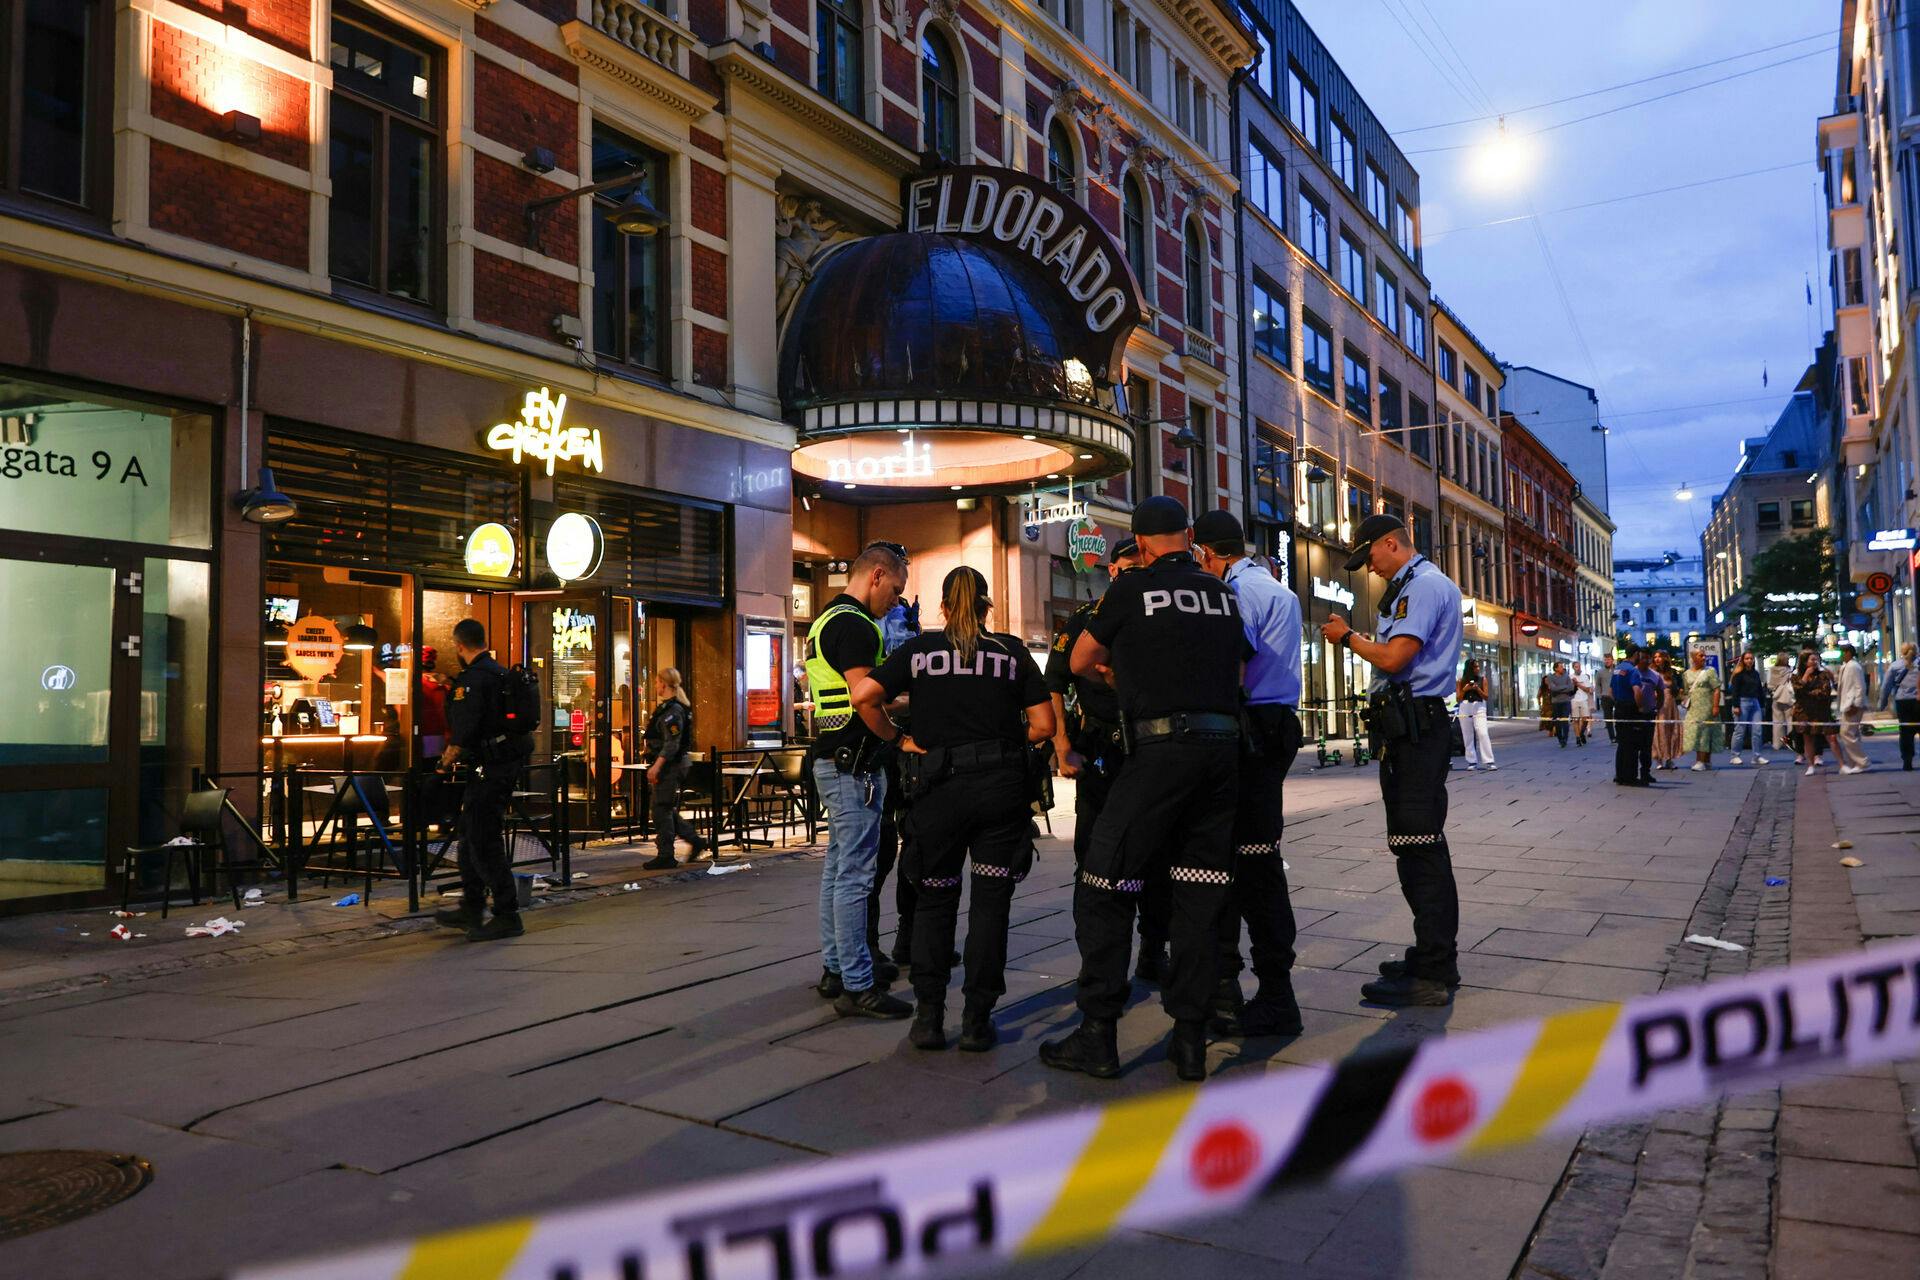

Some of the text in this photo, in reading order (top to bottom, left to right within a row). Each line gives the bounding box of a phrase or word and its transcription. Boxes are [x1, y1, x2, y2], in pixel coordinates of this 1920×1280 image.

[908, 174, 1126, 333] ELDORADO
[0, 446, 148, 487] gata 9 A
[828, 440, 934, 482] norli
[1069, 520, 1106, 561] Greenie
[911, 649, 1017, 681] POLITI
